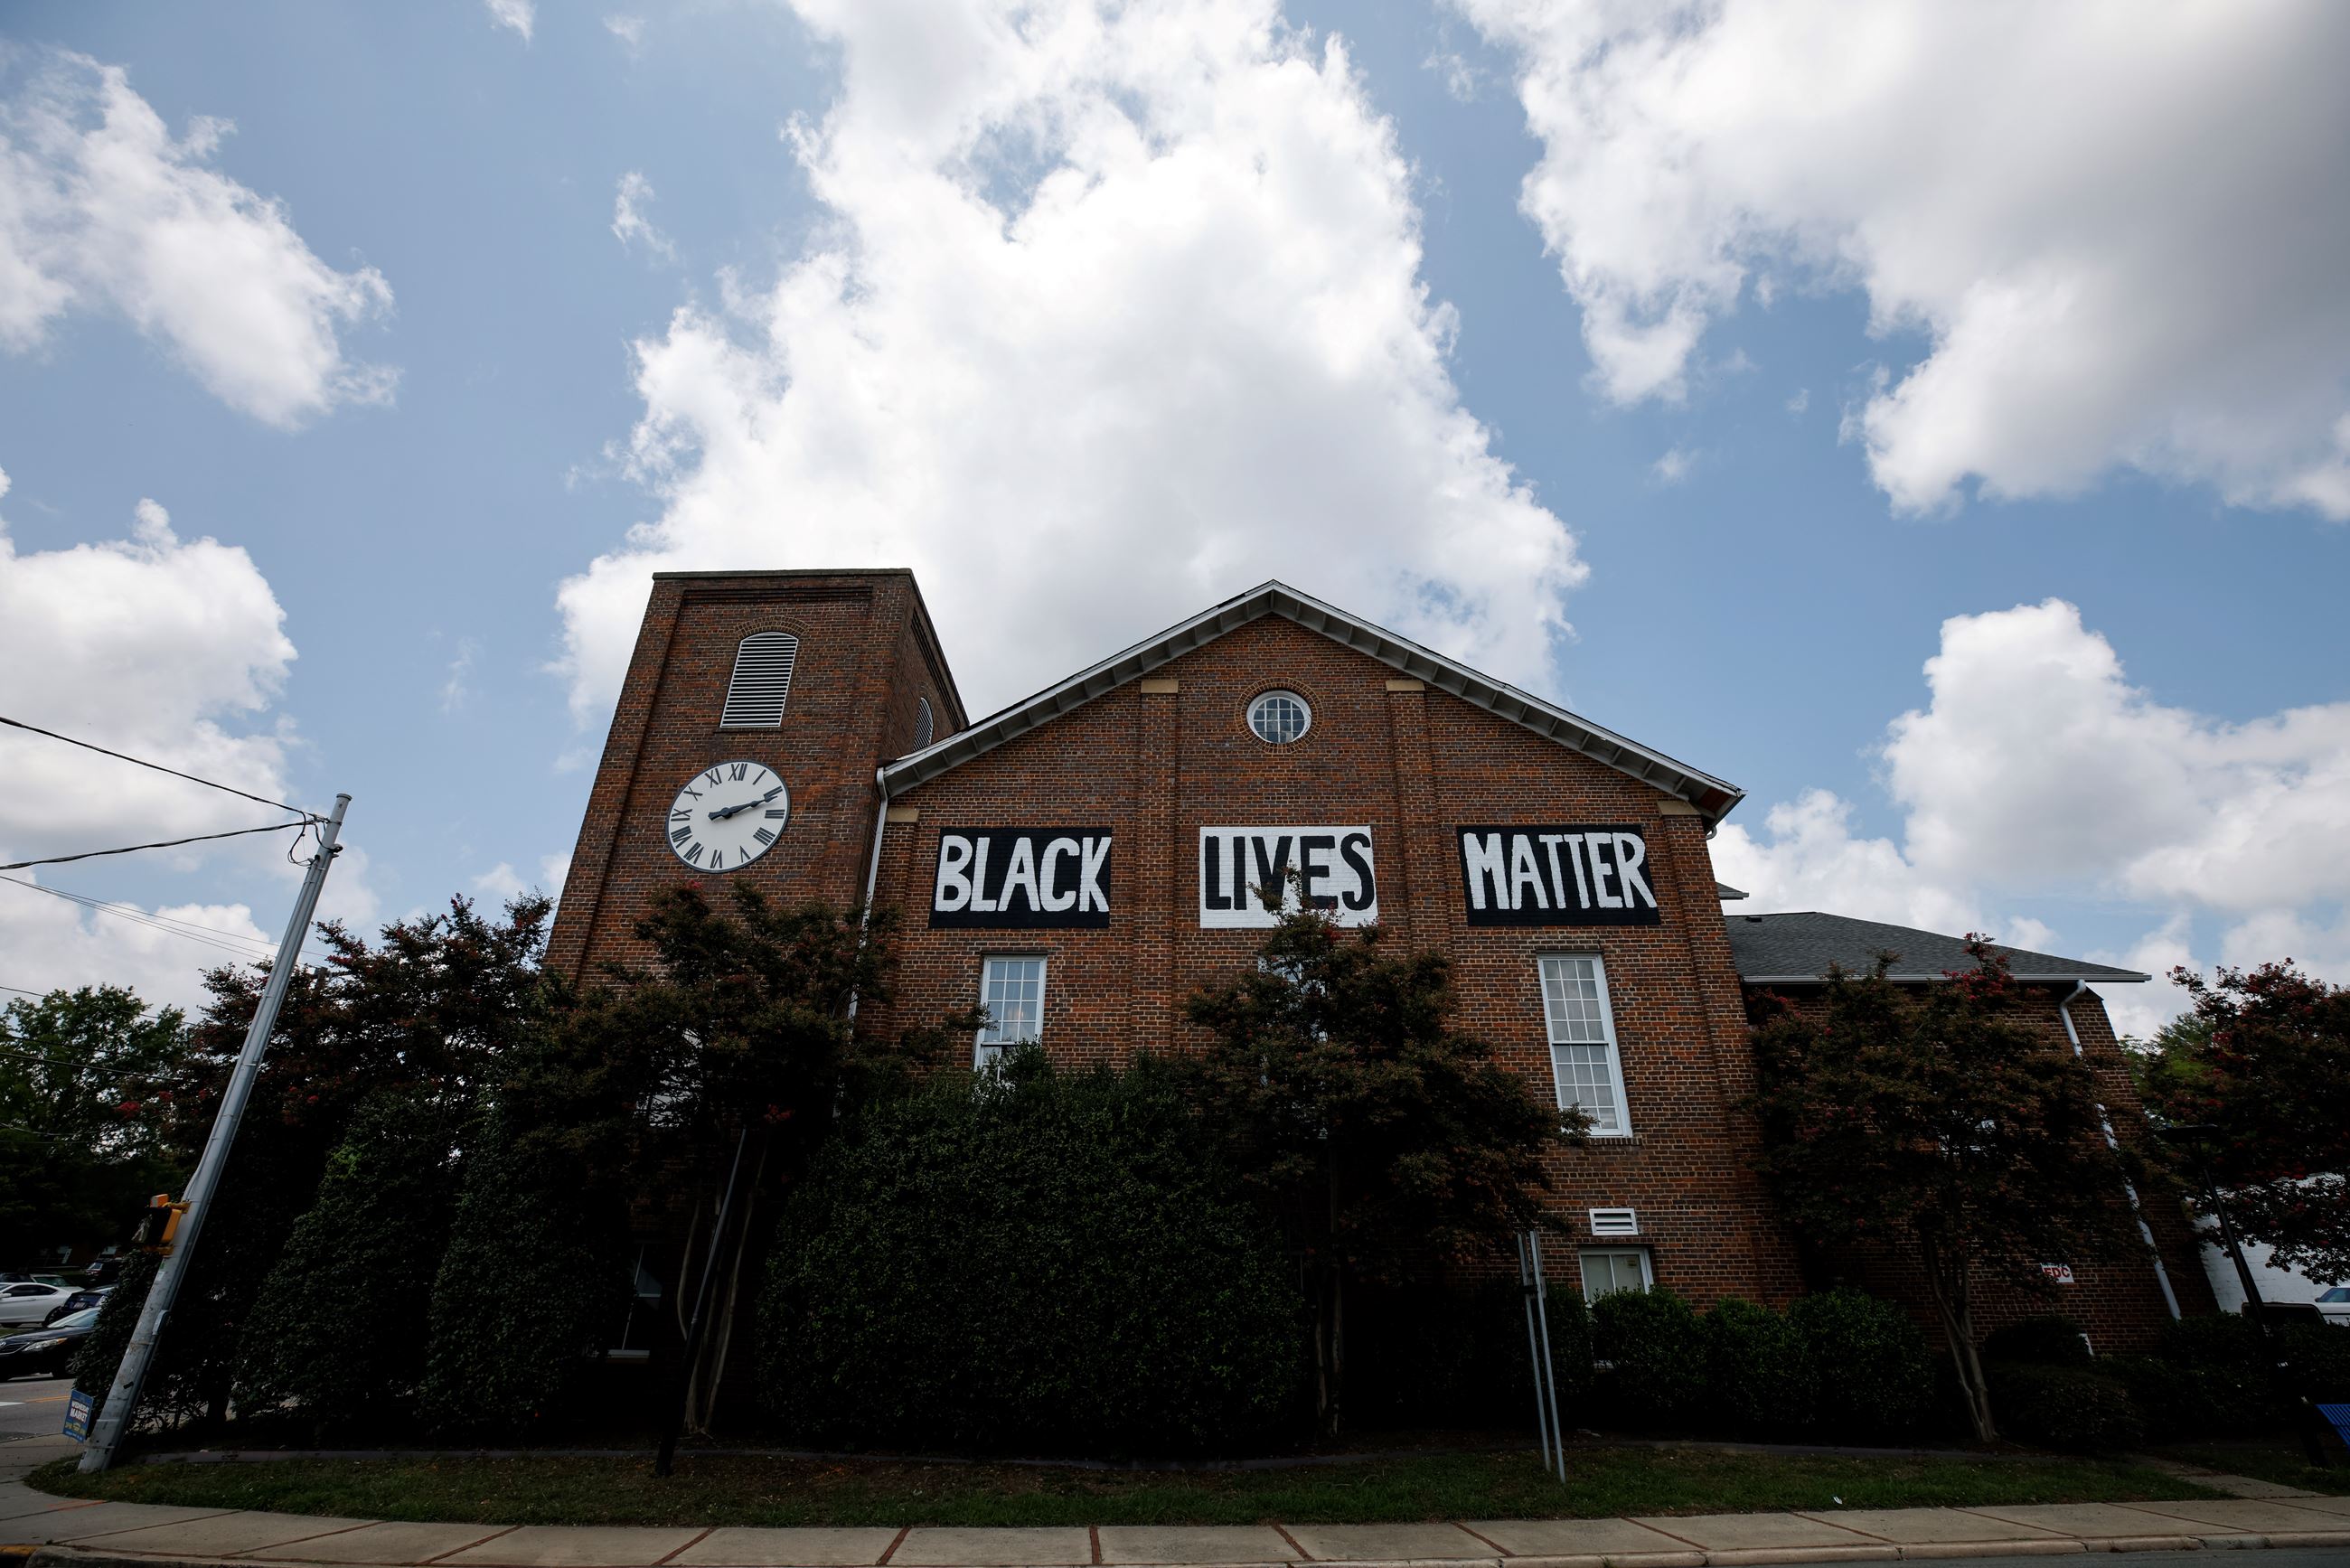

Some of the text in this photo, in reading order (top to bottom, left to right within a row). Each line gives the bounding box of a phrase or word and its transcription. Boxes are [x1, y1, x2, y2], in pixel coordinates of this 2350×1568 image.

[704, 768, 722, 788] XI
[728, 764, 748, 782] XII
[753, 769, 766, 785] I
[682, 785, 703, 802] X
[765, 809, 785, 819] III
[739, 845, 751, 863] V
[935, 831, 1658, 913] BLACK LIVES MATTER
